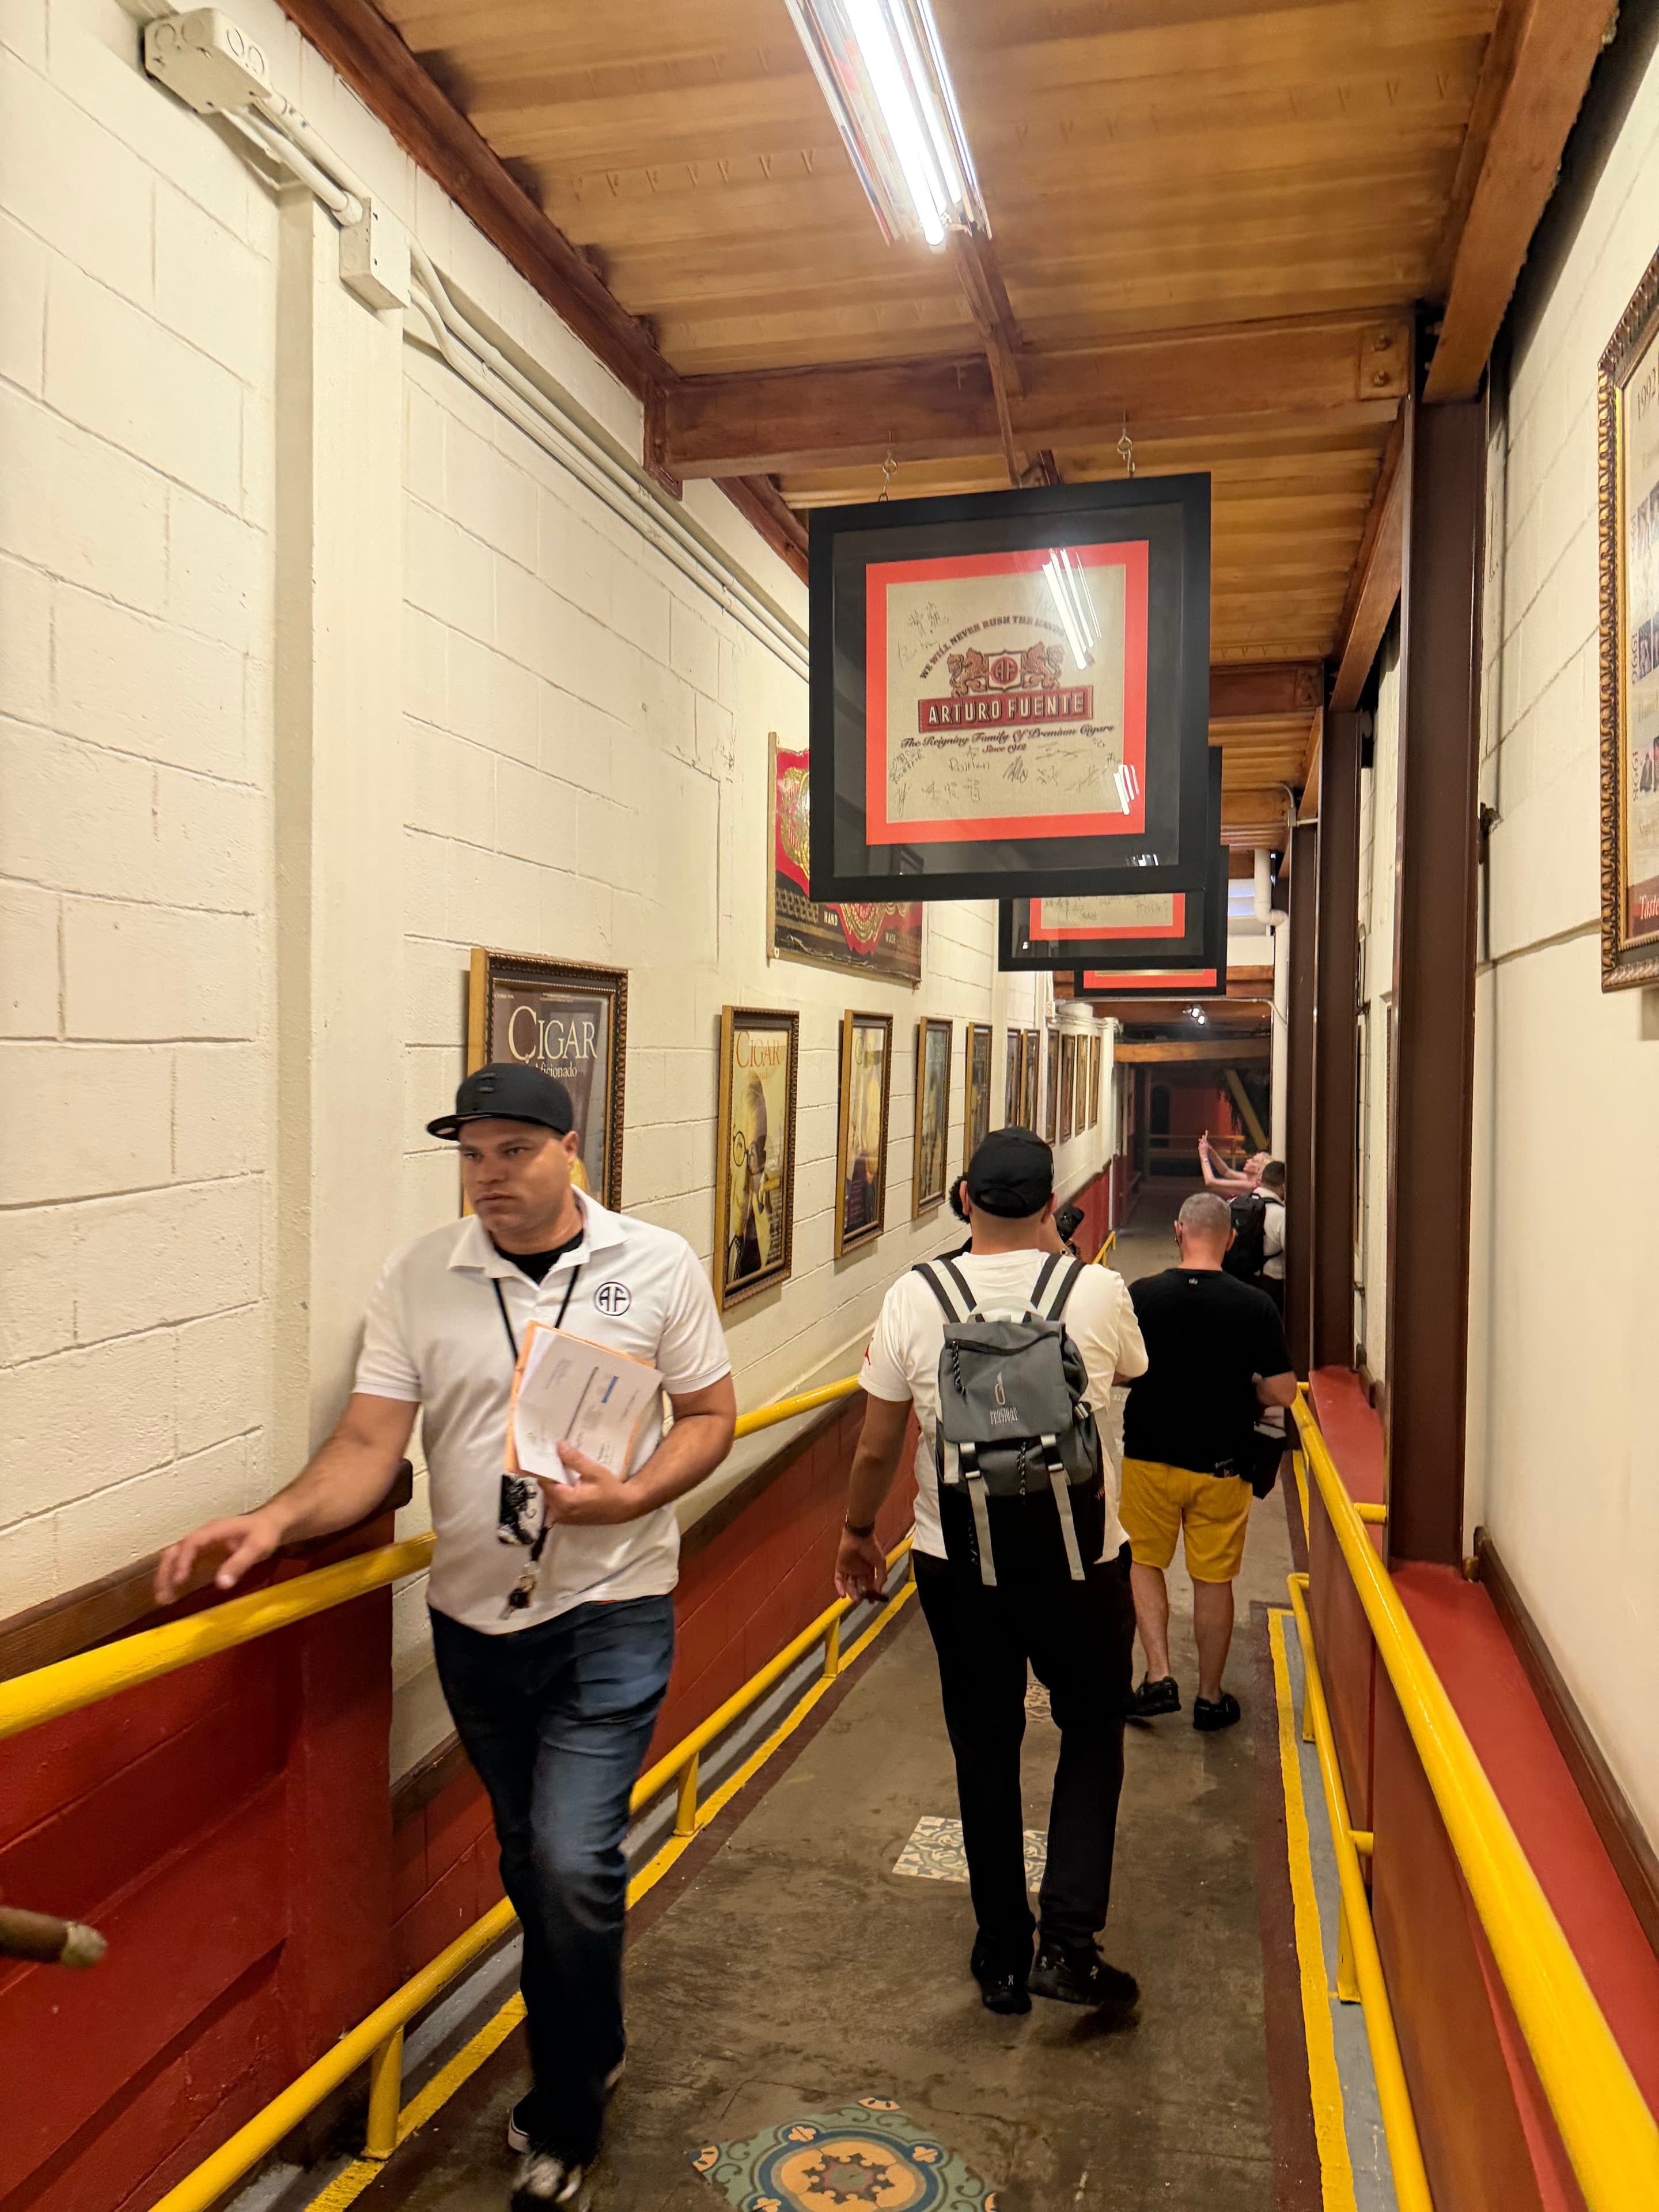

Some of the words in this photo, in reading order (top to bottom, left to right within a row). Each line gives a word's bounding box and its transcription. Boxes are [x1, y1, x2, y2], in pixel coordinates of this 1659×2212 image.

[920, 663, 933, 679] WE
[930, 642, 951, 664] WILL
[950, 623, 982, 646] NEVER
[982, 615, 1010, 629] RUSH
[1012, 615, 1033, 625] THE
[928, 700, 1002, 725] ARTURO
[1007, 692, 1084, 719] FUENTE
[901, 737, 921, 748] The
[922, 736, 969, 748] Reigning
[972, 730, 1009, 744] Family
[1028, 727, 1076, 738] Premium
[1080, 724, 1115, 737] Cigars
[982, 745, 1006, 753] Since
[1008, 743, 1027, 753] 1912
[824, 910, 838, 926] HAND
[508, 1005, 598, 1064] CIGAR
[736, 1031, 781, 1068] CIGAR
